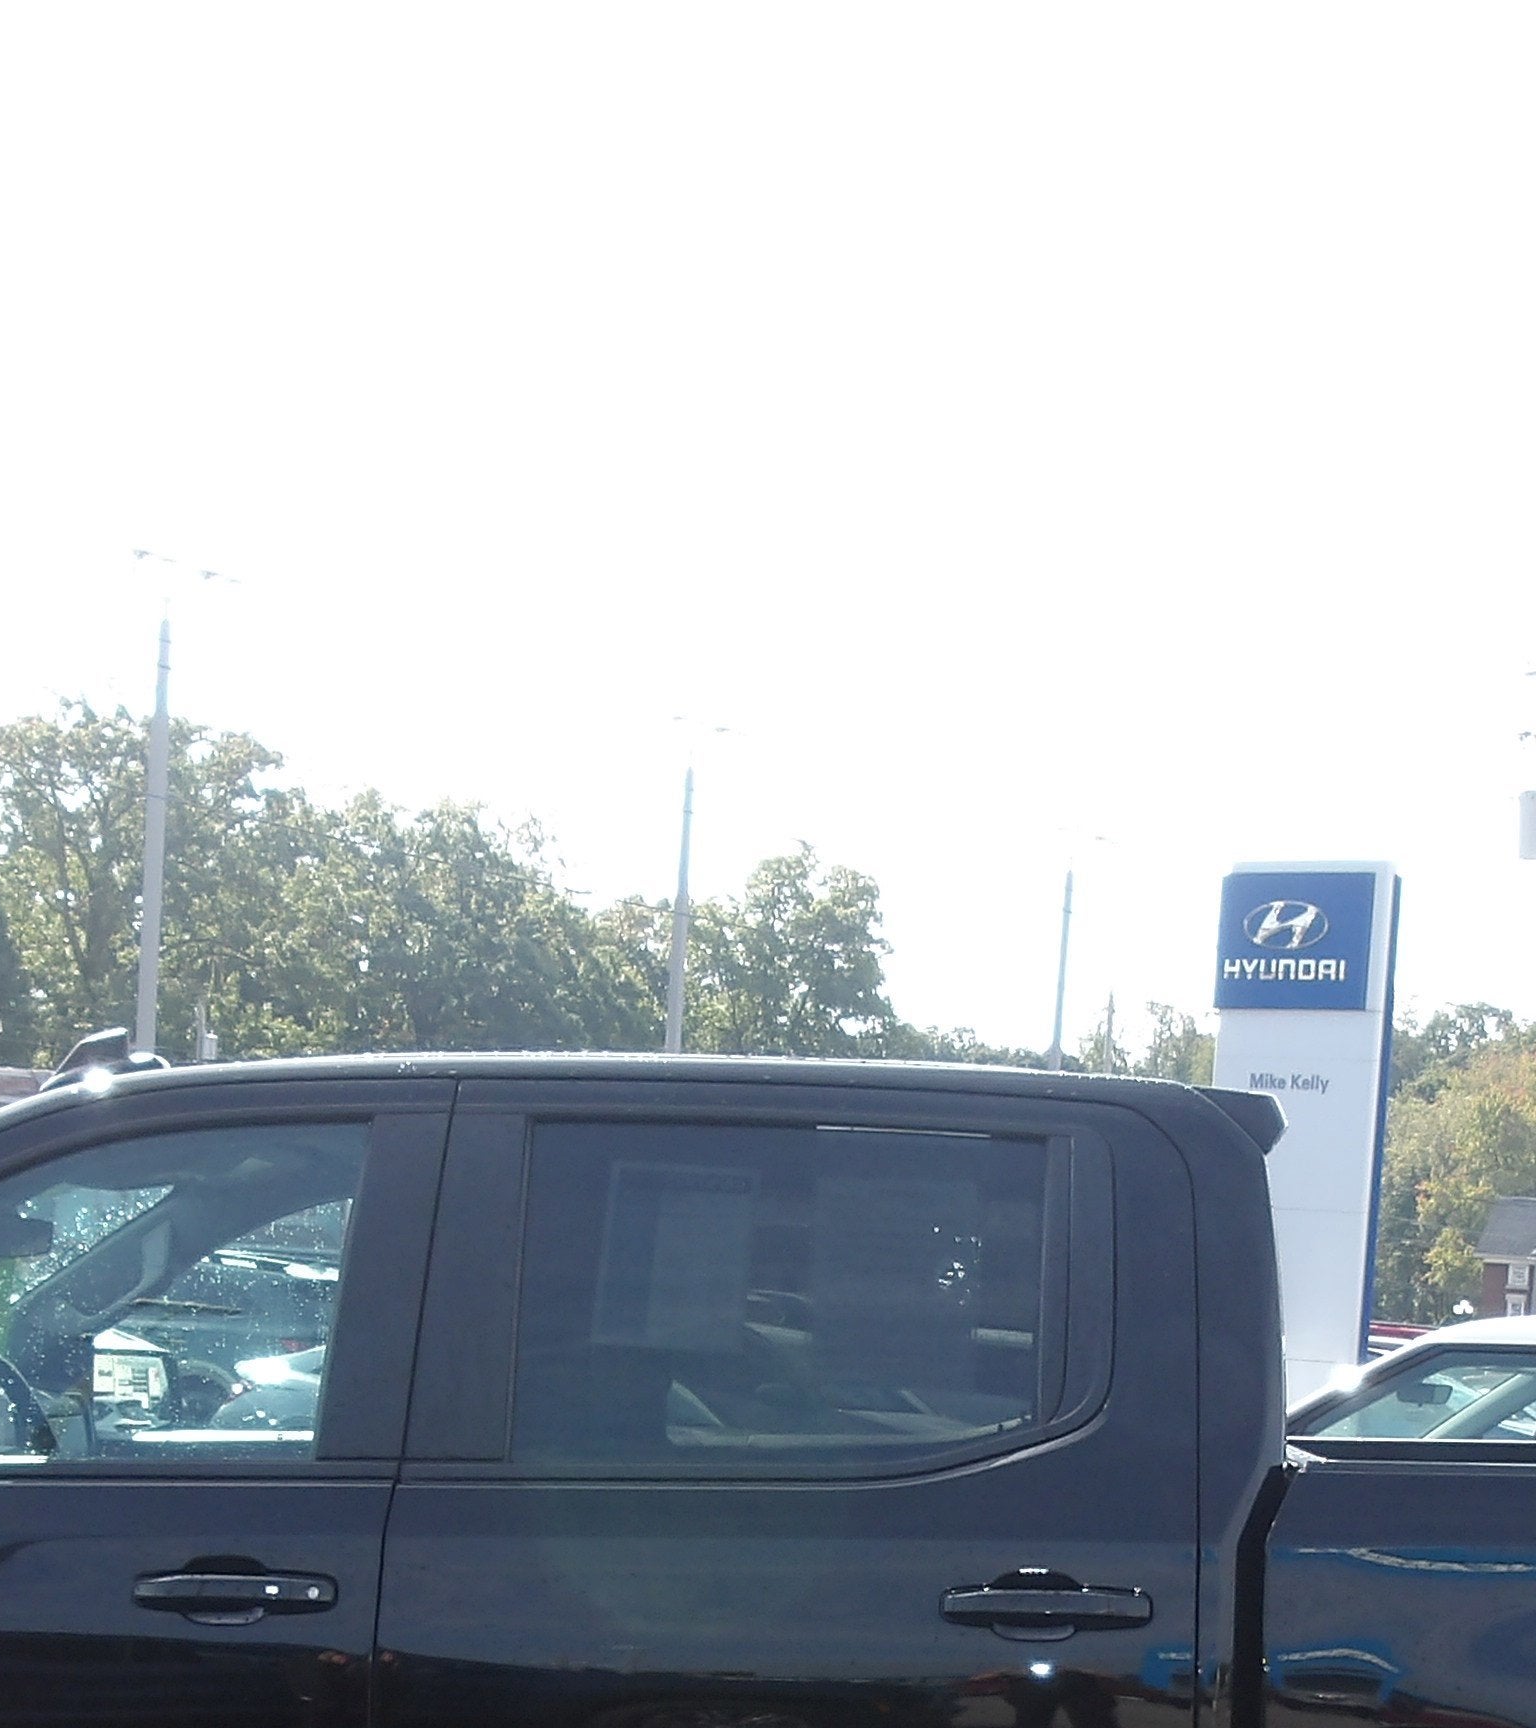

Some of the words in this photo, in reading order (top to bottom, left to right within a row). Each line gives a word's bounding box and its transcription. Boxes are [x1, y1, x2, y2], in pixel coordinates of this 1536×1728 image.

[1222, 958, 1346, 981] HYUNDAI
[1249, 1073, 1286, 1090] Mike
[1290, 1074, 1329, 1094] Kelly
